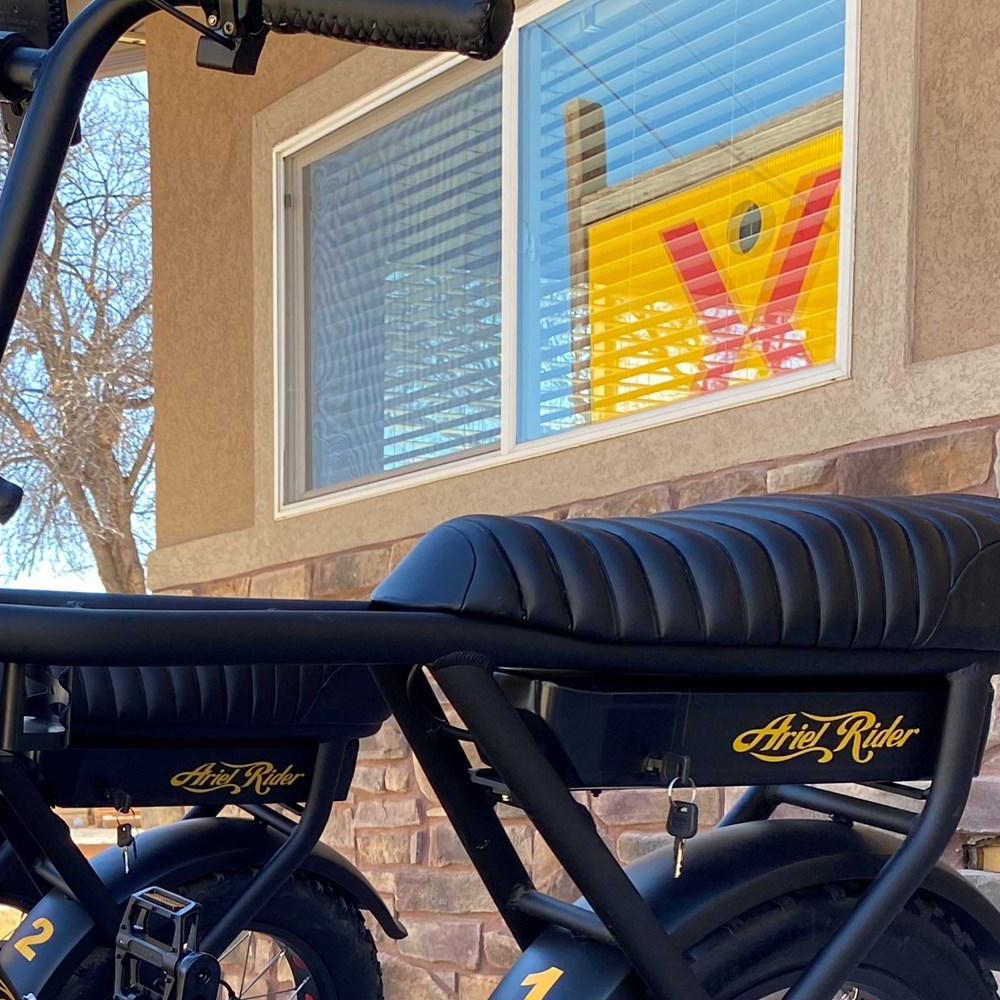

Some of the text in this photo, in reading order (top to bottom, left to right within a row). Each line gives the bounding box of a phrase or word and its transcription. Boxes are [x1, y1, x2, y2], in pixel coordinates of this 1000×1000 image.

[732, 711, 920, 764] Ariel Rider
[170, 761, 305, 796] Ariel Rider
[14, 917, 54, 962] 2
